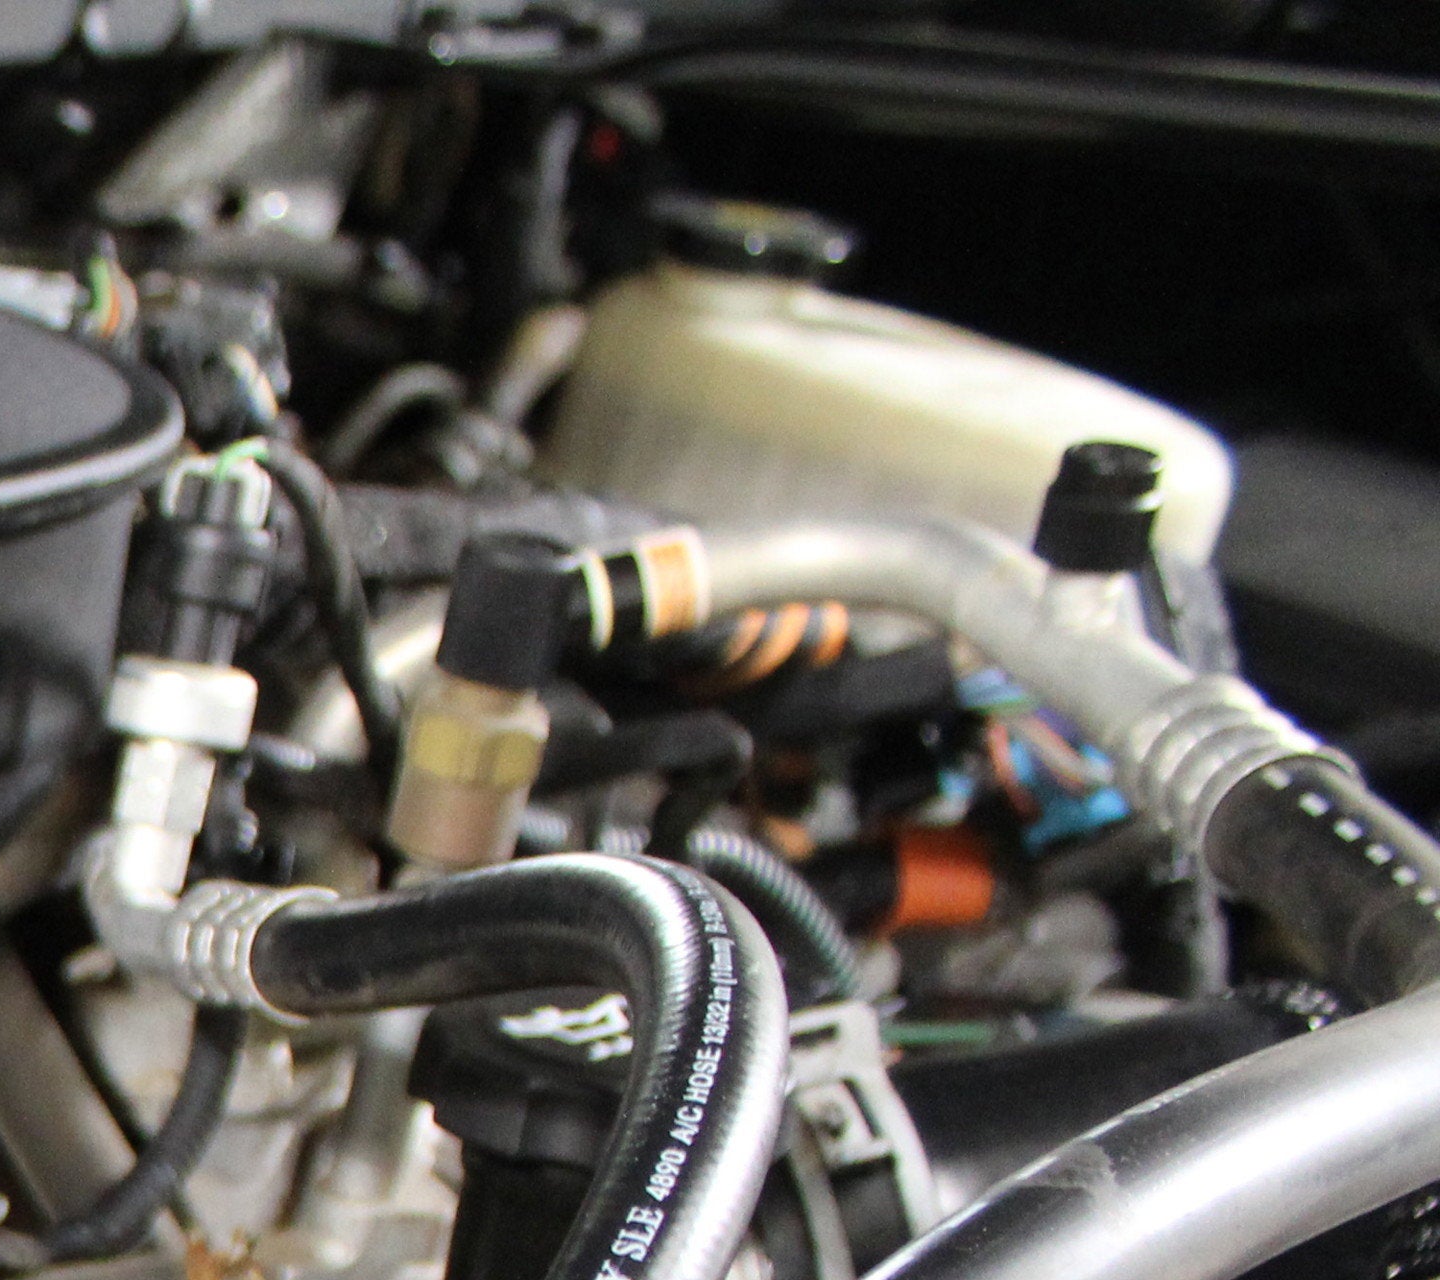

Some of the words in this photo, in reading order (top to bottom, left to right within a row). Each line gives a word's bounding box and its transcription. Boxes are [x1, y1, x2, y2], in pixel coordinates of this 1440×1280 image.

[683, 1046, 722, 1105] HOSE
[670, 1104, 703, 1146] A/C
[646, 1148, 686, 1202] 4890
[611, 1206, 665, 1262] SLE
